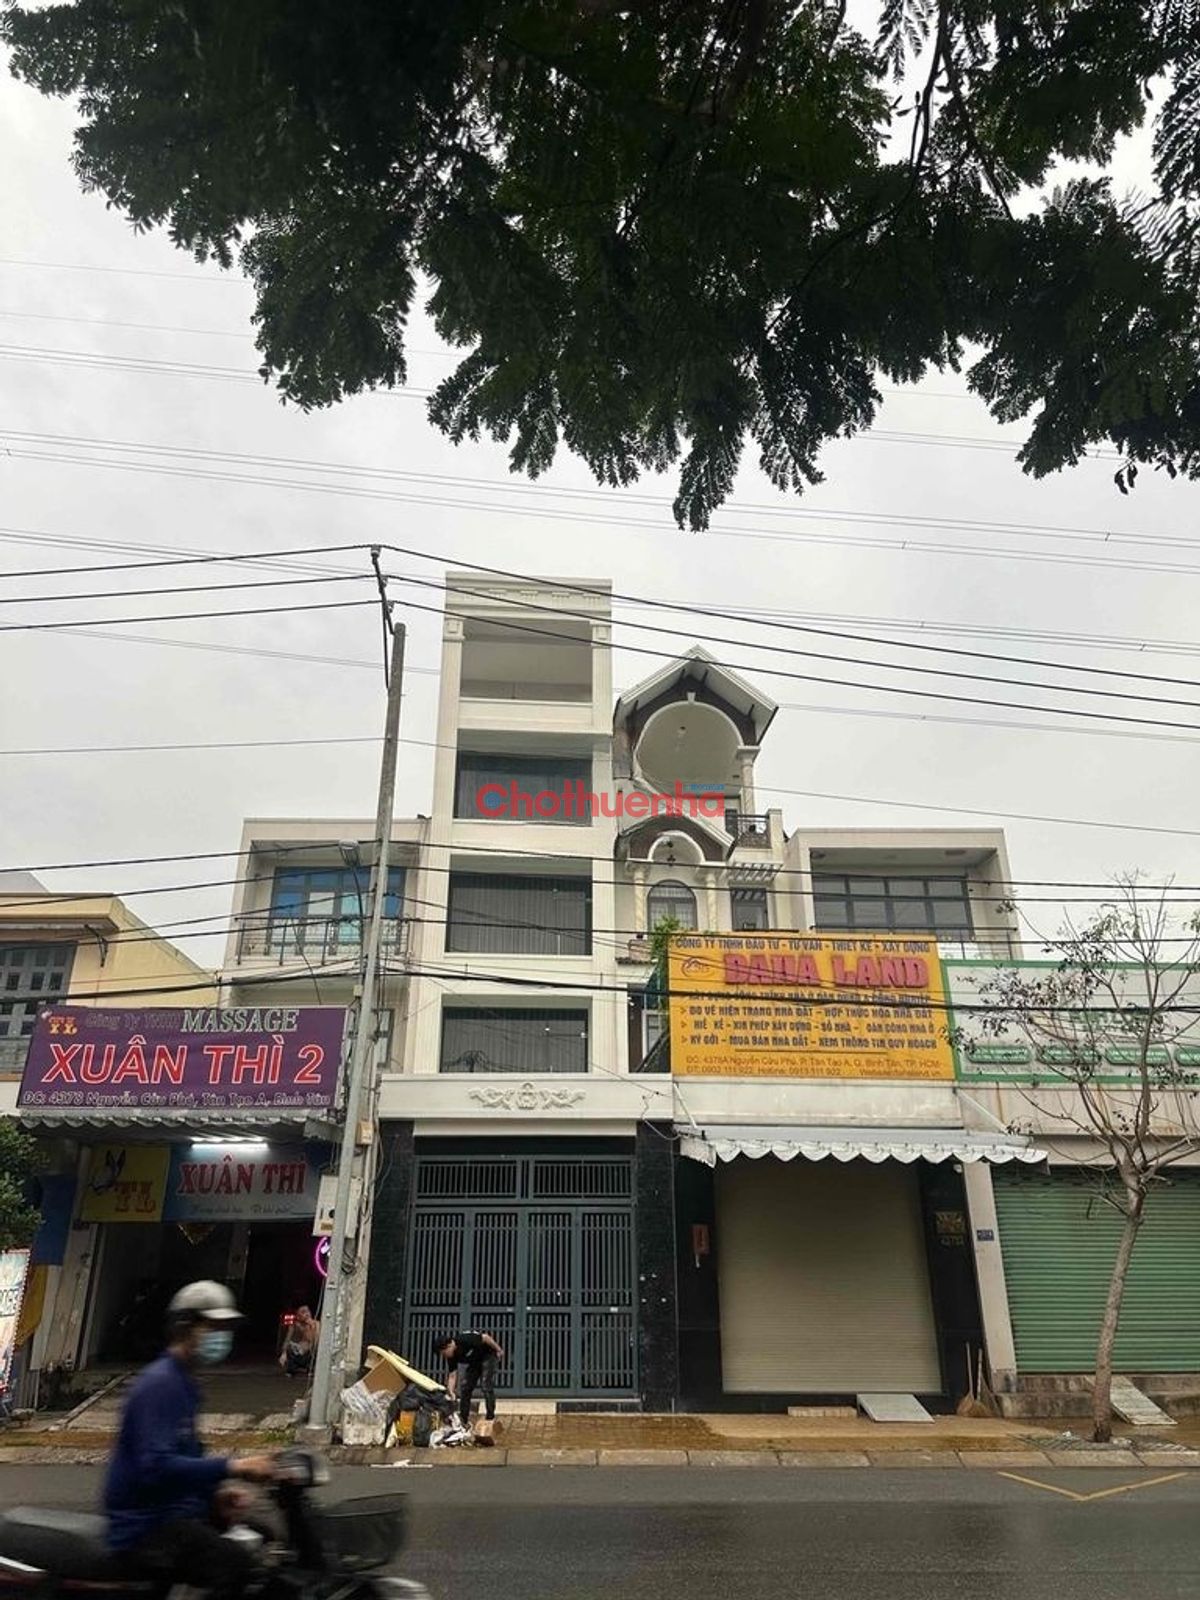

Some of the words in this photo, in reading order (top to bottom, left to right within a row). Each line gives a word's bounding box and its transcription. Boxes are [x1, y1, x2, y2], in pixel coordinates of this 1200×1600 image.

[830, 954, 929, 988] LAND
[180, 1009, 299, 1033] MASSAGE
[41, 1034, 188, 1084] XUÂN
[203, 1034, 285, 1084] THÌ
[293, 1044, 325, 1084] 2
[177, 1153, 254, 1195] XUÂN
[262, 1153, 307, 1195] THÌ
